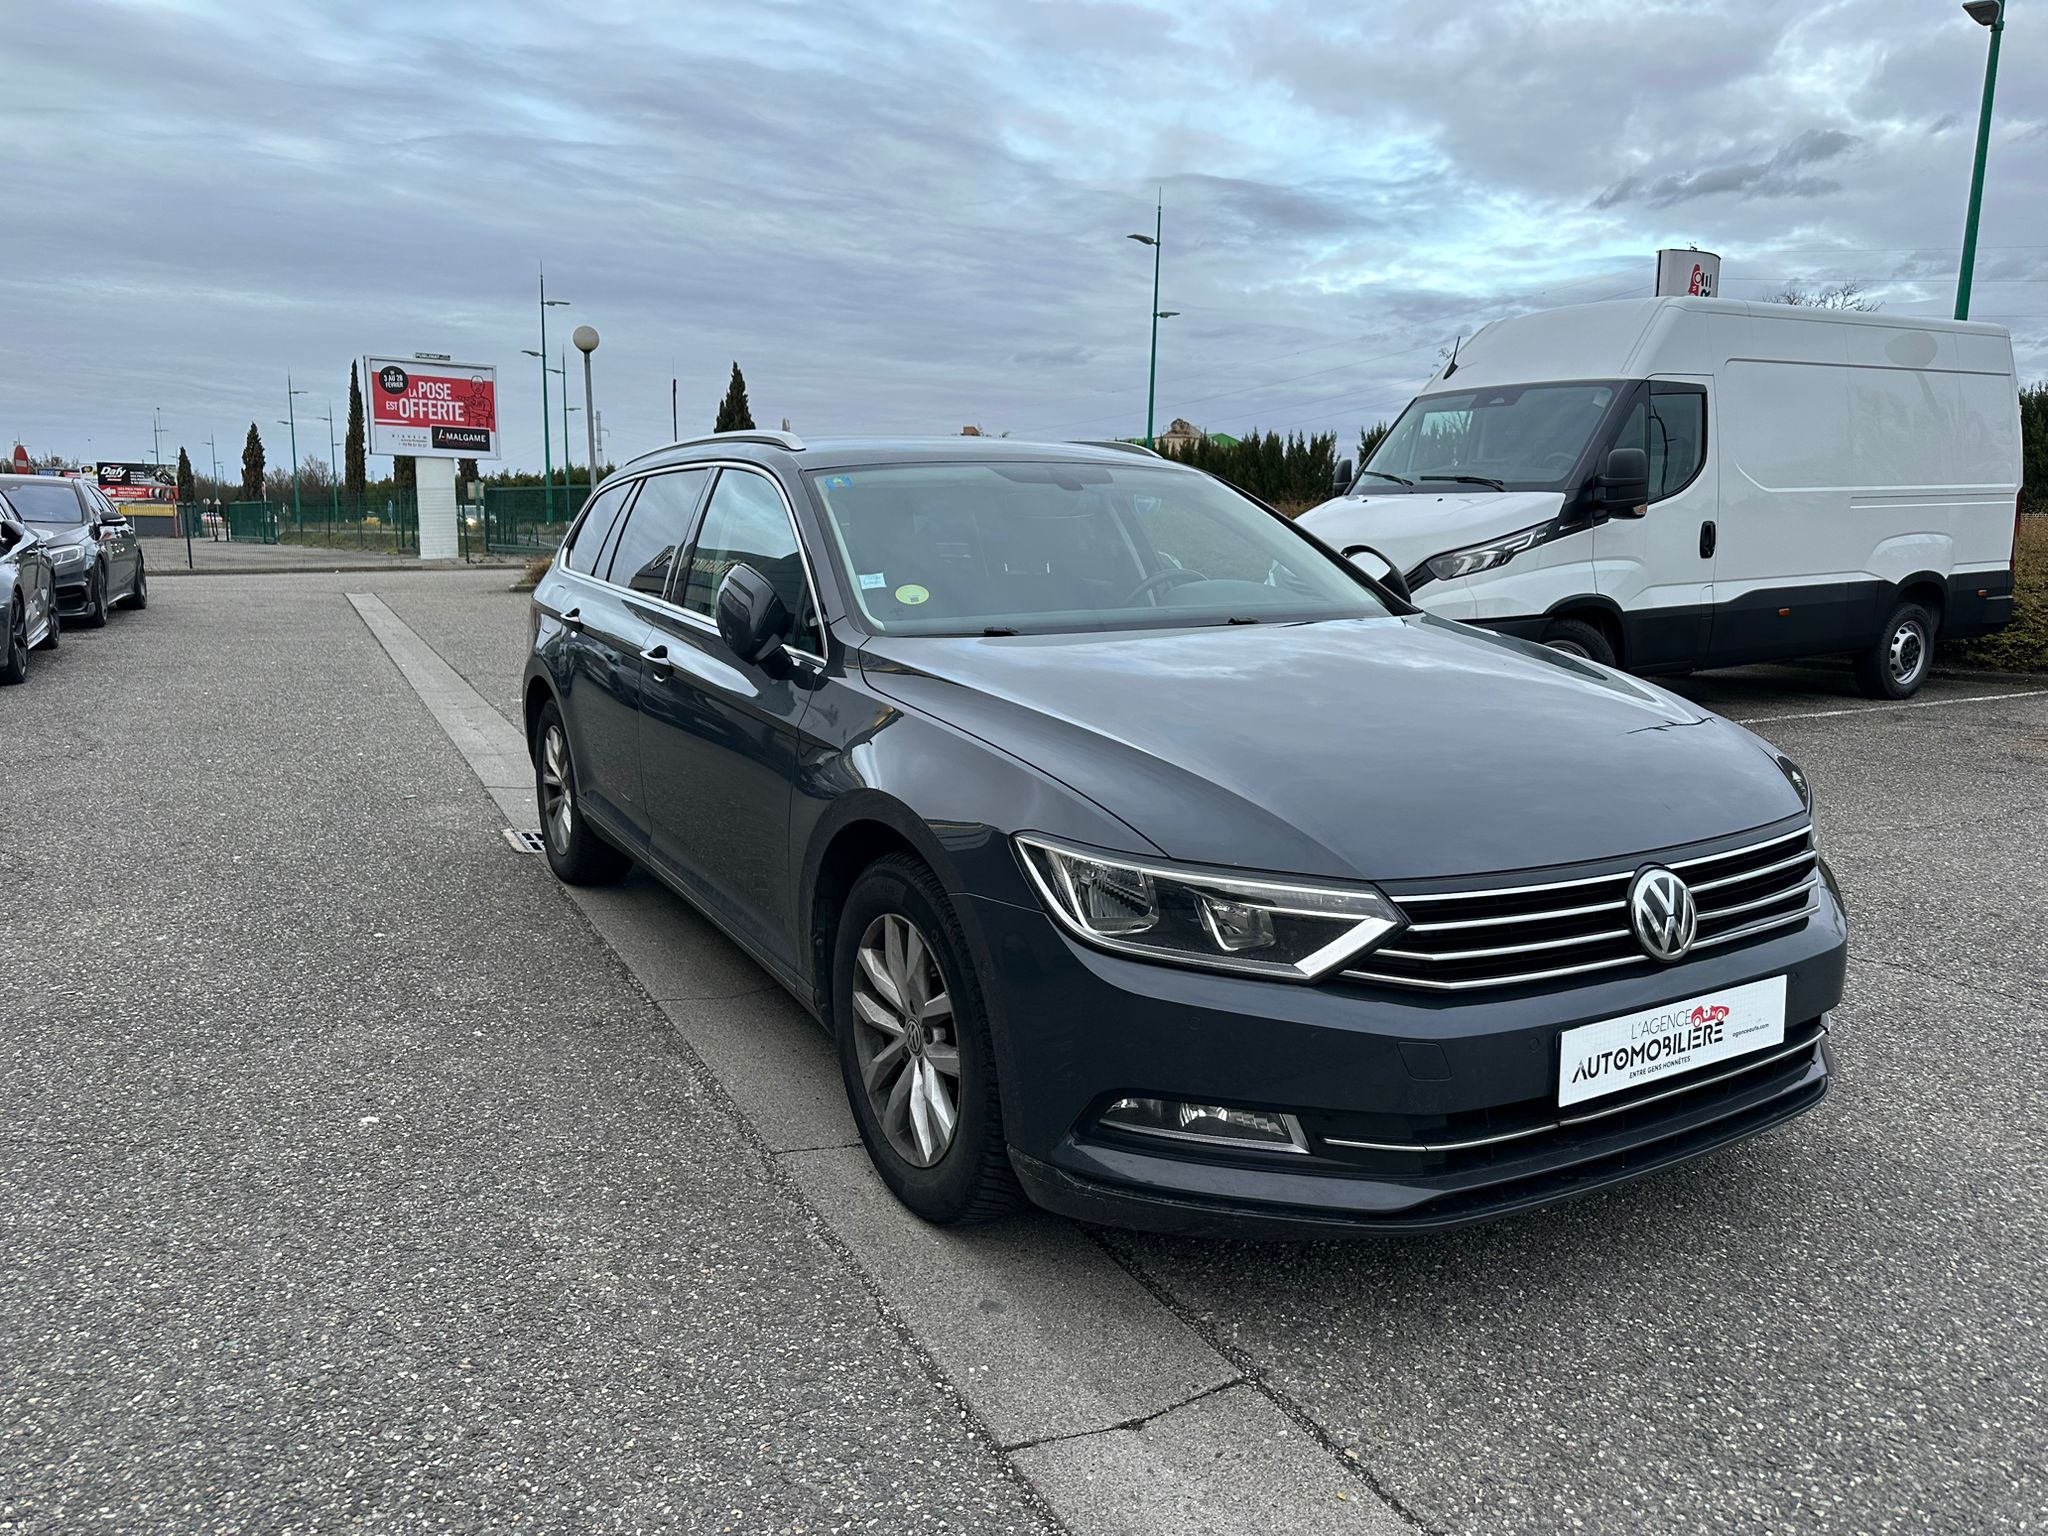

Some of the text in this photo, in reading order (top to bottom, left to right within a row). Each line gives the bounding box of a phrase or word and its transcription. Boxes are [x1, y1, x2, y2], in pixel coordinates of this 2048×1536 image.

[408, 381, 452, 400] LA POSE
[386, 398, 464, 421] EST OFFERTE
[100, 466, 127, 478] Dafy
[1634, 870, 1696, 959] VW
[1631, 1008, 1692, 1040] L'AGENCE
[1629, 1068, 1647, 1079] ENTRE
[1647, 1063, 1662, 1074] GENS
